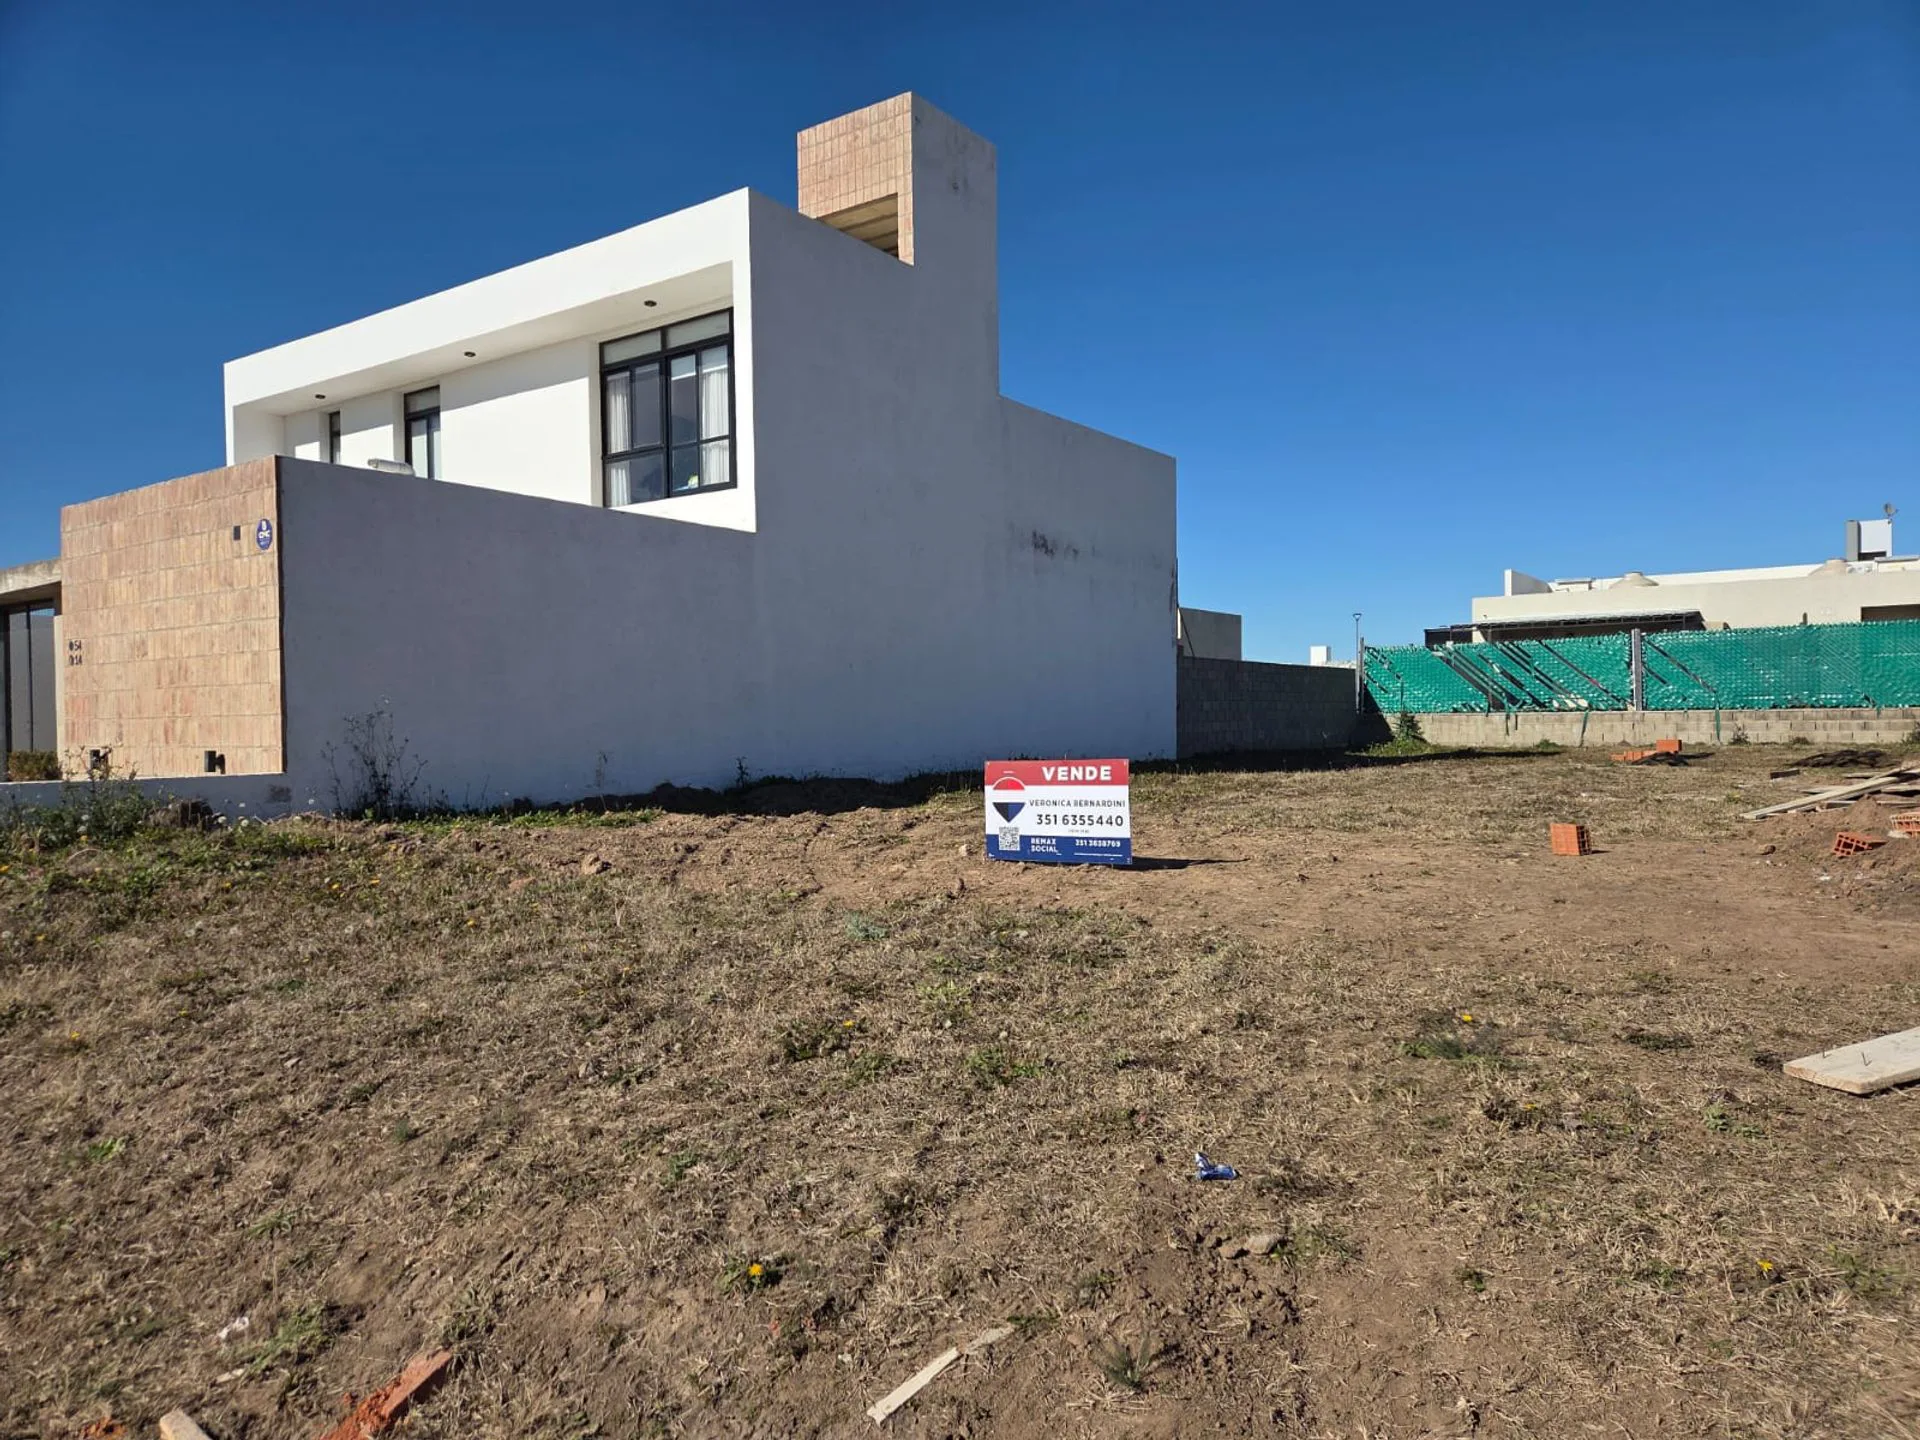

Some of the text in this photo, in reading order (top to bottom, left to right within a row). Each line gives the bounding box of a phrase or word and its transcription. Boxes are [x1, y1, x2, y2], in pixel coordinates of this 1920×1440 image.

[1041, 765, 1112, 781] VENDE
[1073, 800, 1126, 808] BERNARDINI
[1036, 814, 1124, 827] 351 6355440
[1030, 837, 1056, 845] REMAX
